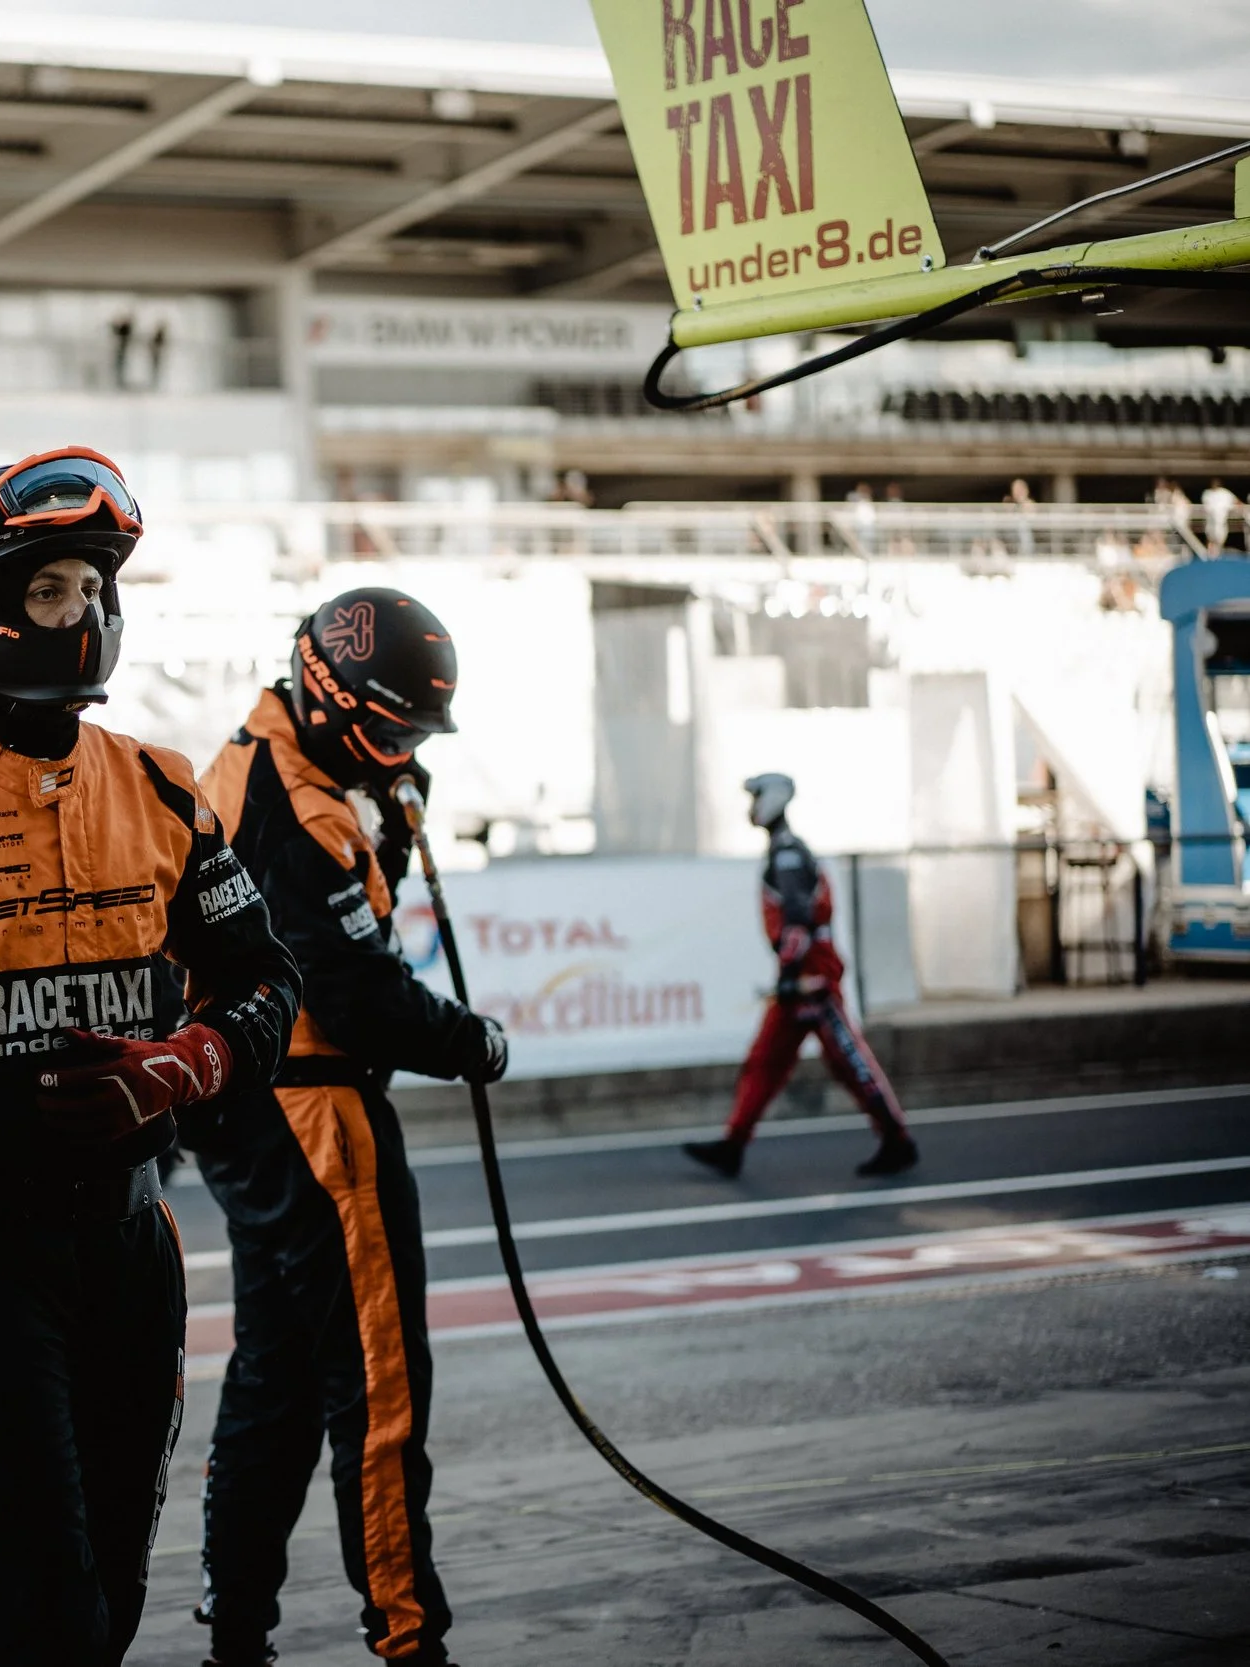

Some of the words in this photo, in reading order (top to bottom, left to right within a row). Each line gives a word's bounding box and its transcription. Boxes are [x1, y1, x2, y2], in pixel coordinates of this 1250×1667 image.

[666, 73, 814, 236] TAXI
[688, 218, 922, 292] under8.de
[466, 911, 628, 953] TOTAL
